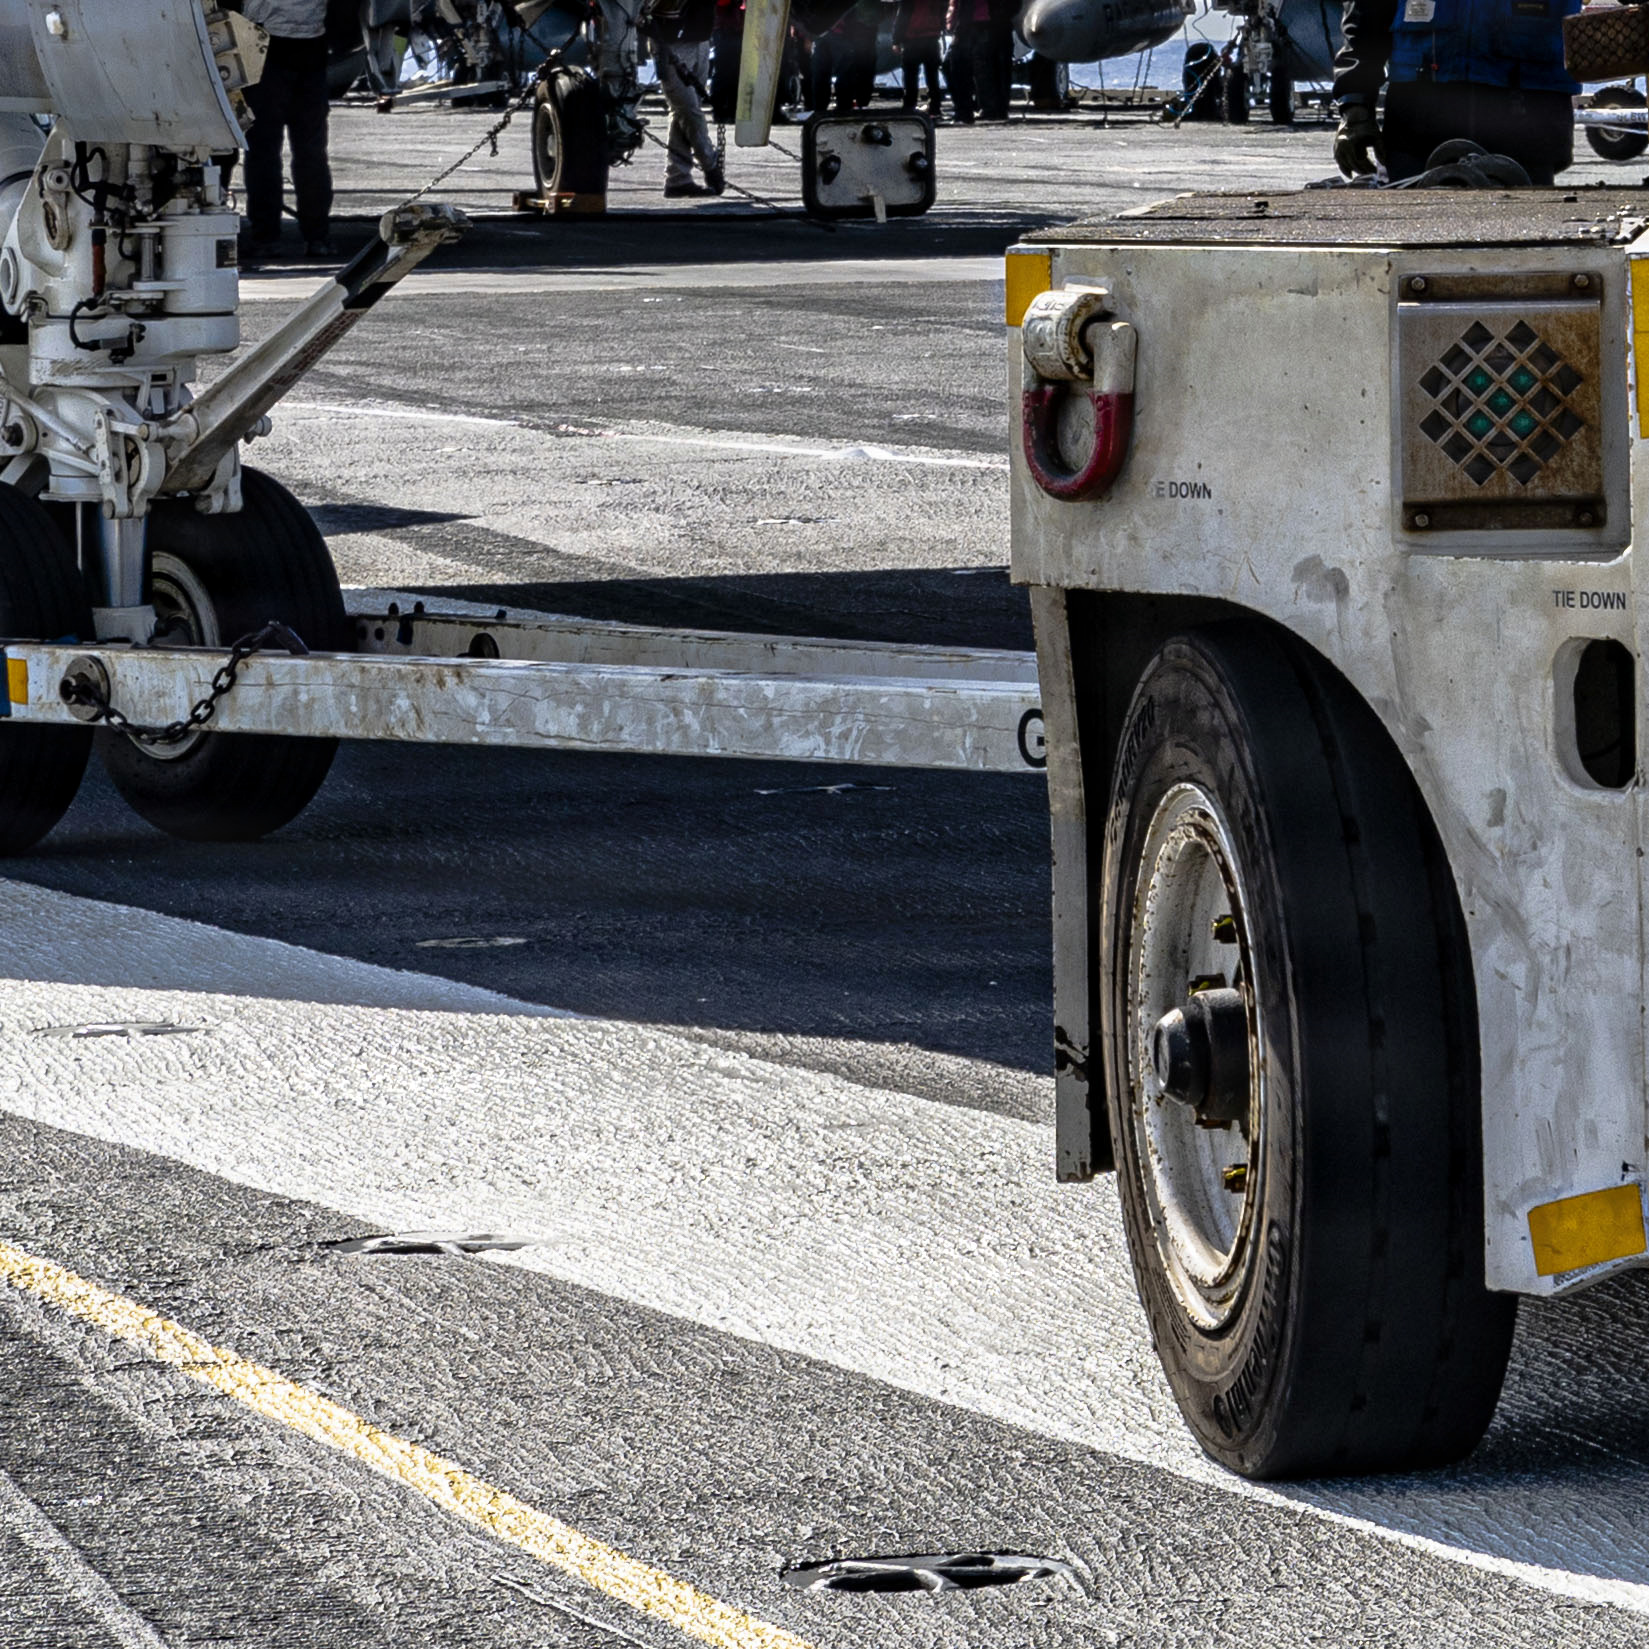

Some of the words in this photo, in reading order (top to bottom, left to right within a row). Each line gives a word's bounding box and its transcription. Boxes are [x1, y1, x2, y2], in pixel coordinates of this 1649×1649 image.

[1169, 481, 1211, 499] DOWN
[1552, 590, 1575, 608] TIE
[1580, 591, 1626, 610] DOWN
